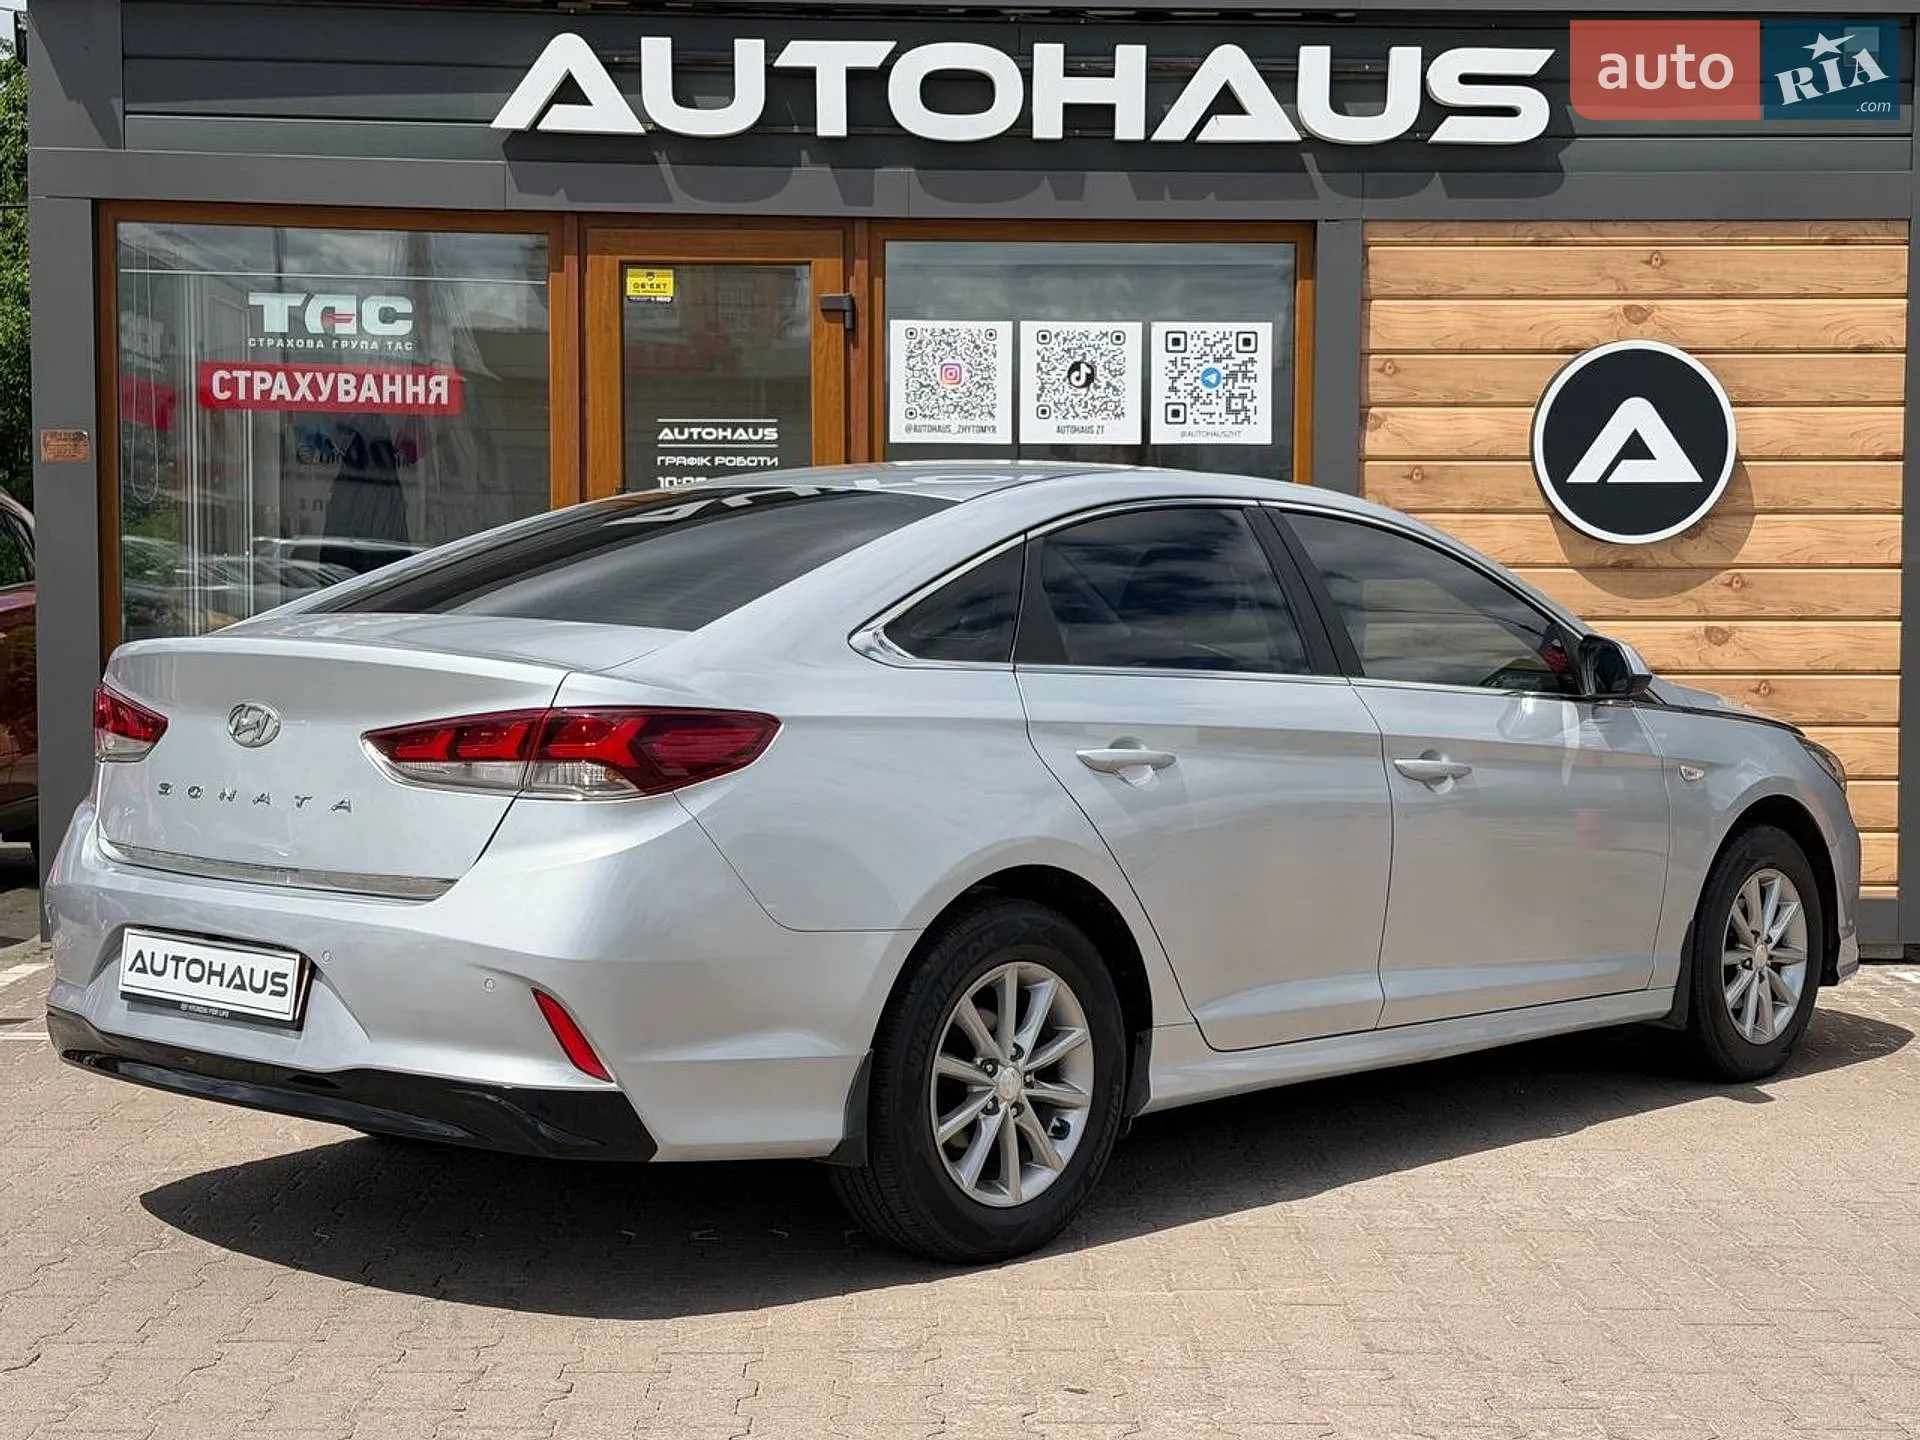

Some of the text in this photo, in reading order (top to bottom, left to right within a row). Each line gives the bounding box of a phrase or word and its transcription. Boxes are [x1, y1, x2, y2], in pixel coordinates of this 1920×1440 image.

[489, 32, 1555, 144] AUTOHAUS
[248, 338, 414, 351] СТРАХОВА ГРУПА ТАС
[211, 369, 449, 406] СТРАХУВАННЯ
[658, 427, 779, 441] AUTOHAUS
[1056, 425, 1094, 434] AUTOHAUS
[656, 455, 779, 467] ГРАФІК РОБОТИ
[158, 782, 352, 813] SONATA
[127, 948, 289, 998] AUTOHAUS
